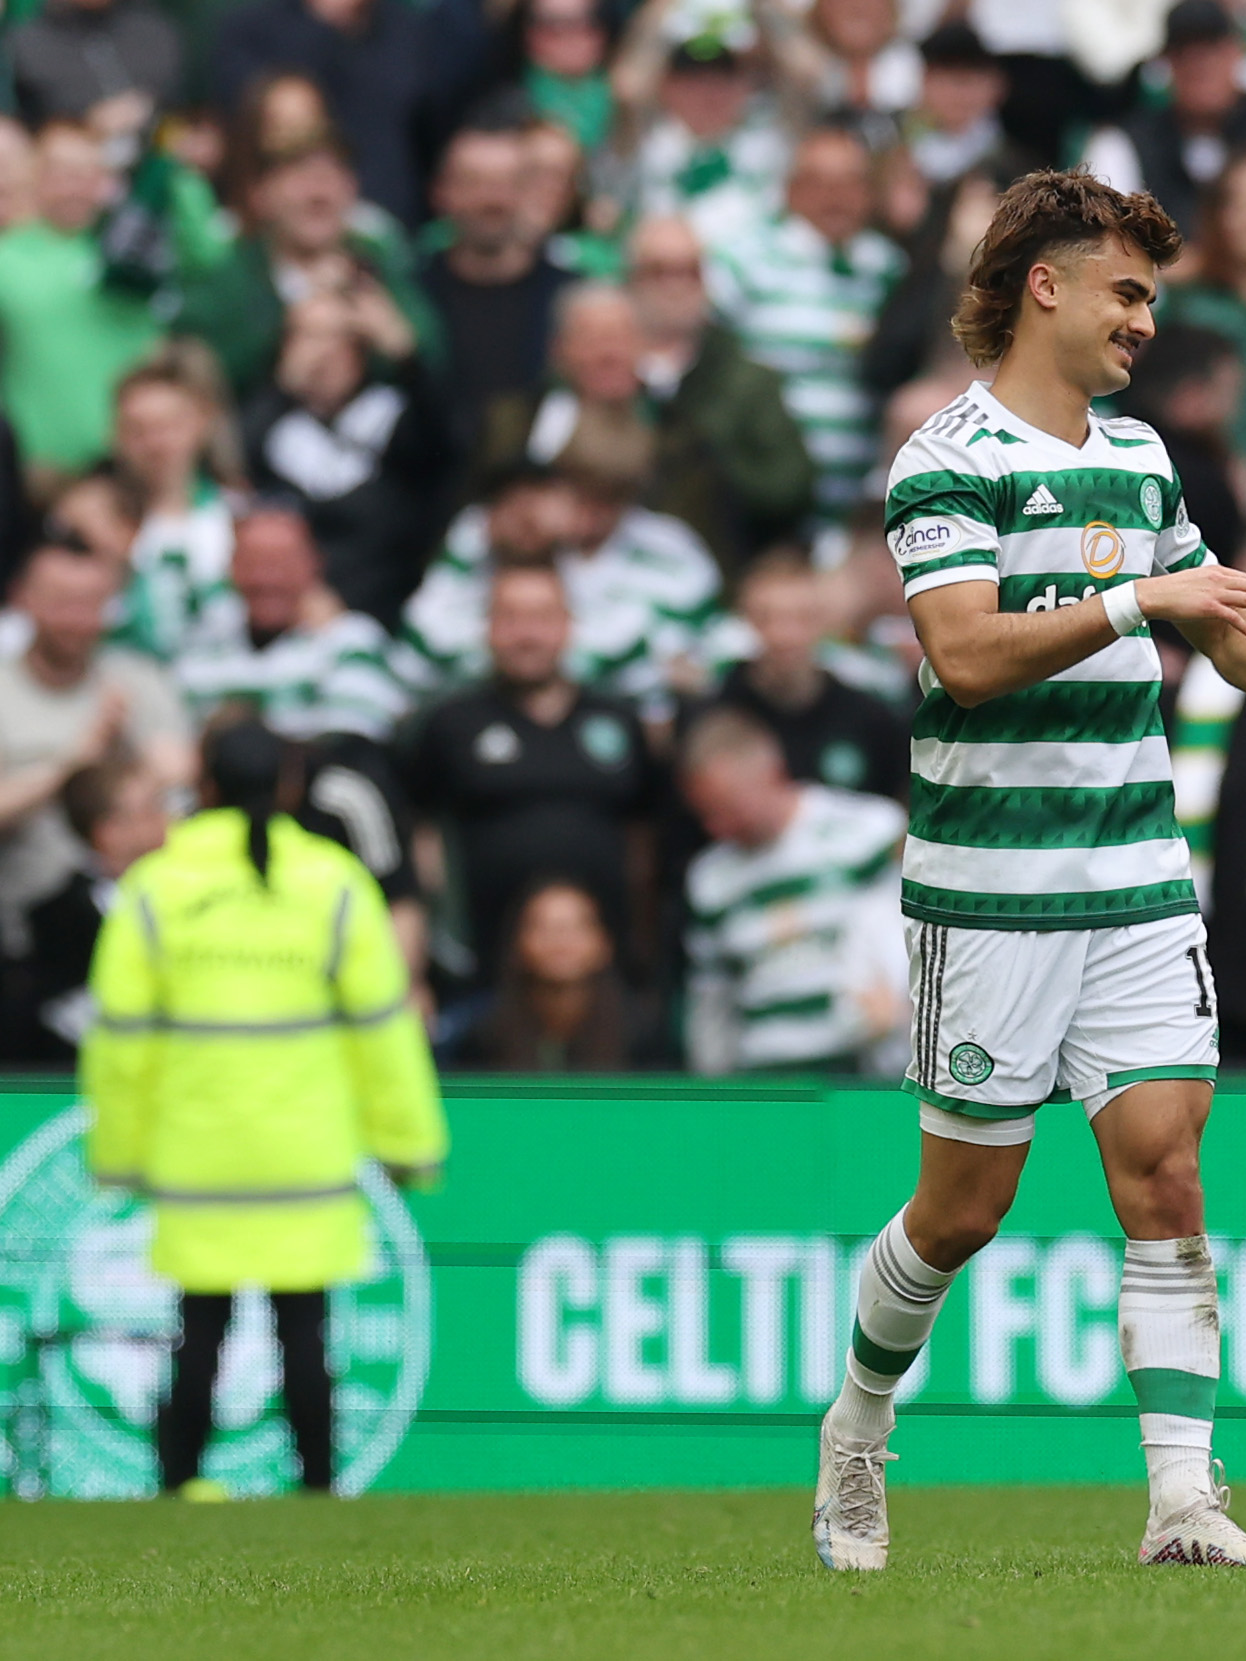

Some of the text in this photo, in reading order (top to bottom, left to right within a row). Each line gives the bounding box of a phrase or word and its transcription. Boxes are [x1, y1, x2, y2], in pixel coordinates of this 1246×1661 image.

[1022, 501, 1064, 515] adidas
[906, 524, 950, 547] cinch
[1185, 945, 1213, 1019] 1
[516, 1231, 929, 1406] CELTI
[970, 1232, 1120, 1406] FC
